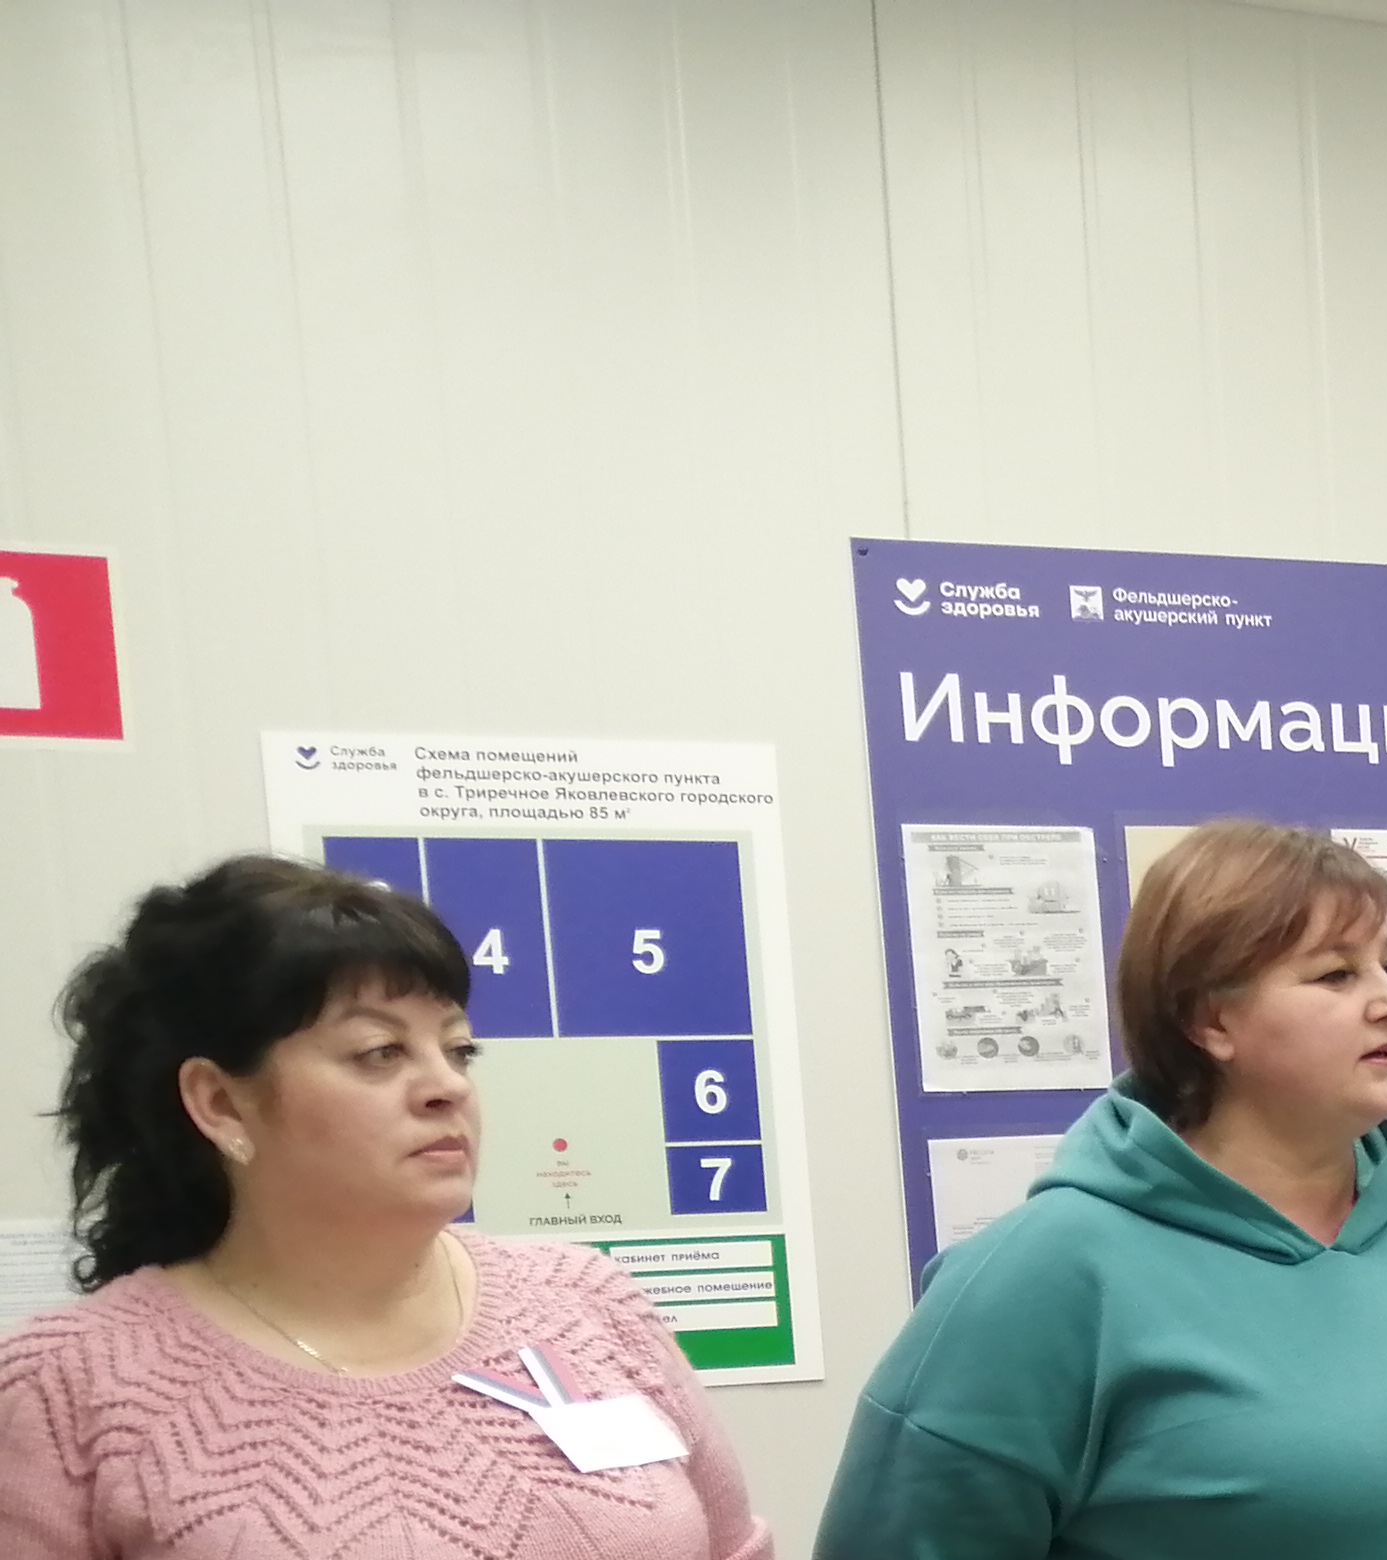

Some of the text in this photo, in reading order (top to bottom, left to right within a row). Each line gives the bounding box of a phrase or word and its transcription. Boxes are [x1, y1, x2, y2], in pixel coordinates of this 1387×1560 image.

[939, 581, 1021, 601] Служба
[1112, 587, 1238, 608] Фельдшерско-
[941, 601, 1040, 619] здоровья
[1113, 609, 1272, 629] акушерский пункт
[330, 745, 386, 758] Служба
[414, 746, 578, 764] Схема помещений
[332, 760, 397, 772] здоровья
[416, 766, 720, 787] фельдшерско-акушерского пункта
[418, 786, 774, 805] в с. Триречное Яковлевского городского
[420, 806, 483, 820] округа,
[488, 808, 584, 820] площадью
[589, 806, 609, 819] 85
[472, 929, 509, 975] 4
[631, 929, 665, 975] 5
[694, 1070, 728, 1114] 6
[700, 1158, 733, 1201] 7
[529, 1214, 623, 1227] ГЛАВНЫЙ ВХОД
